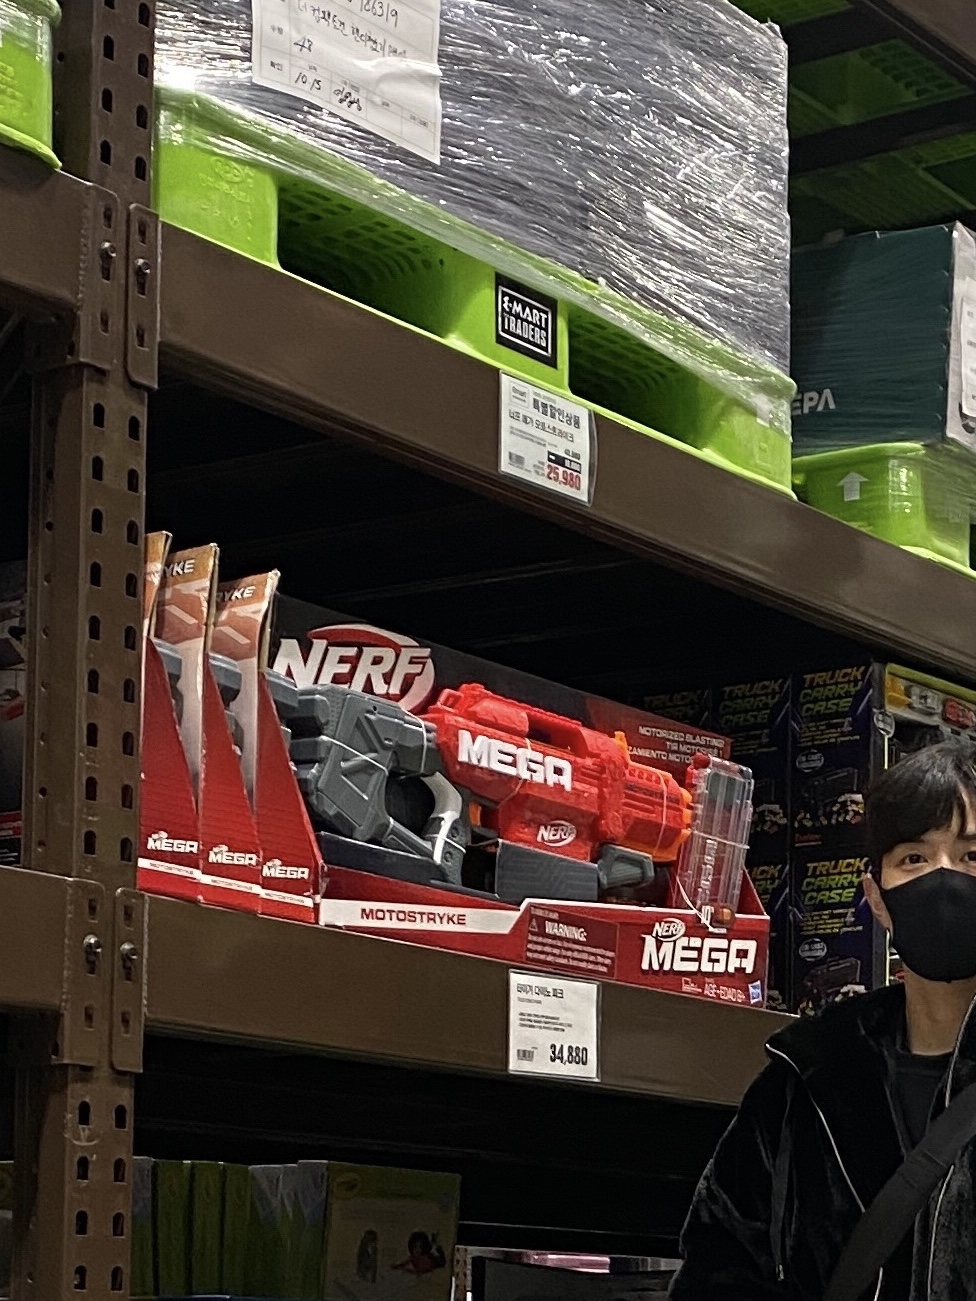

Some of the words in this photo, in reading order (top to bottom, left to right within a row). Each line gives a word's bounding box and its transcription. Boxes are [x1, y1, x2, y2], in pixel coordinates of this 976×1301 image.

[792, 388, 836, 416] EPA
[273, 637, 431, 695] NERF
[457, 729, 572, 792] MEGA
[147, 837, 199, 854] MEGA
[537, 824, 576, 847] NERF
[208, 850, 258, 867] MEGA
[806, 857, 870, 876] TRUCK
[262, 866, 310, 880] MEGA
[360, 907, 467, 926] MOTOSTRYKE
[652, 920, 684, 937] NERF
[641, 933, 758, 975] MEGA
[549, 1043, 589, 1066] 34,880
